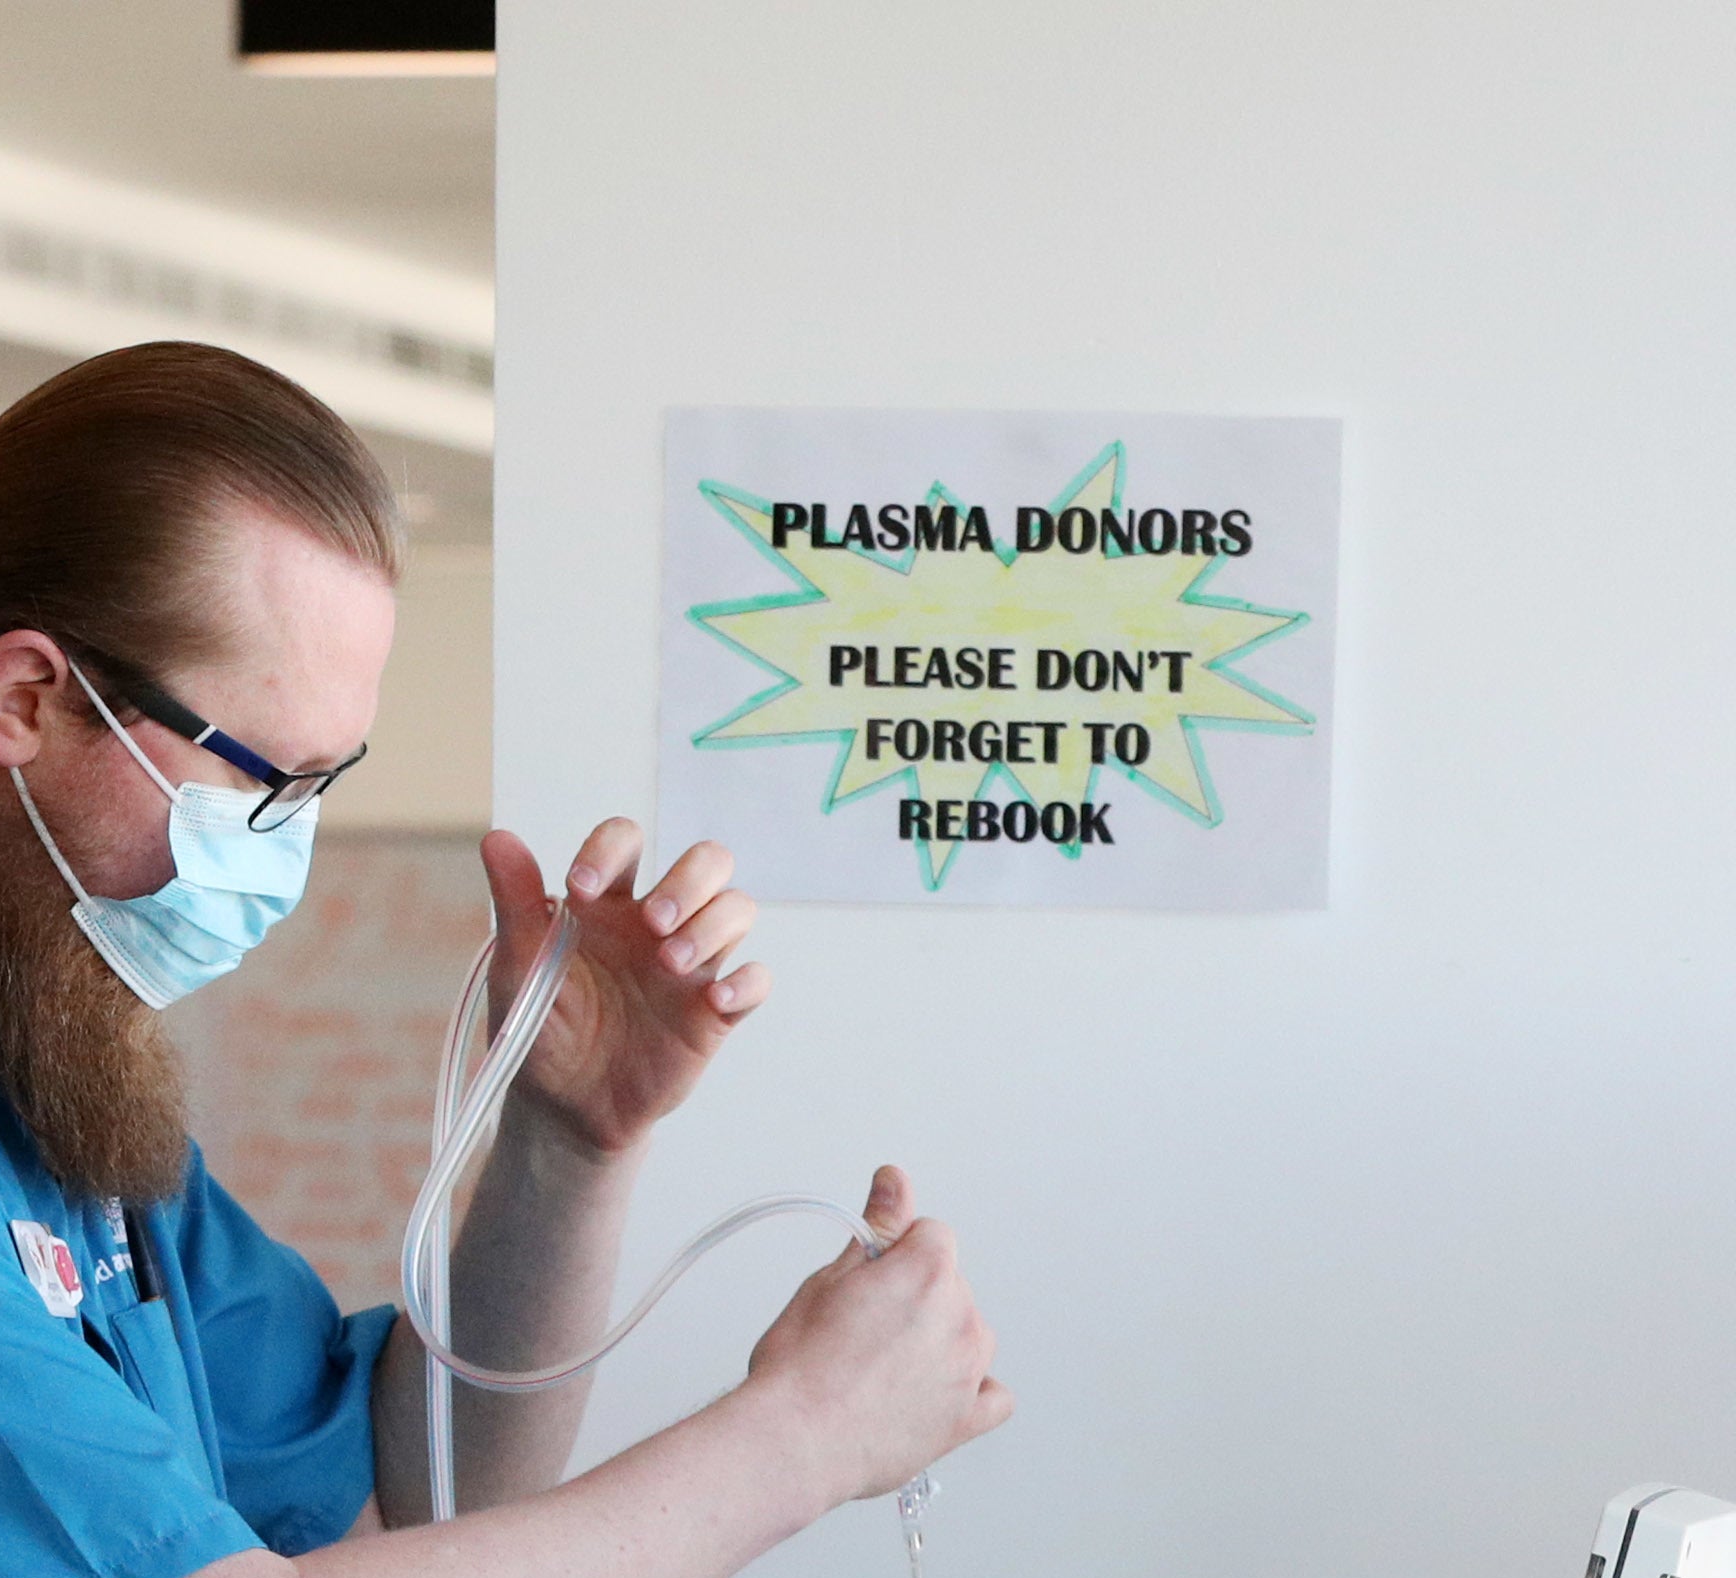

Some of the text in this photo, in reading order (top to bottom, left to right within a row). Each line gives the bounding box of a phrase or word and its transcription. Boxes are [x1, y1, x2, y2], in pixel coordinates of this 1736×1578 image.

[771, 501, 1253, 558] PLASMA DONORS
[828, 644, 1193, 694] PLEASE DON'T
[865, 718, 1151, 767] FORGET TO
[898, 798, 1114, 845] REBOOK
